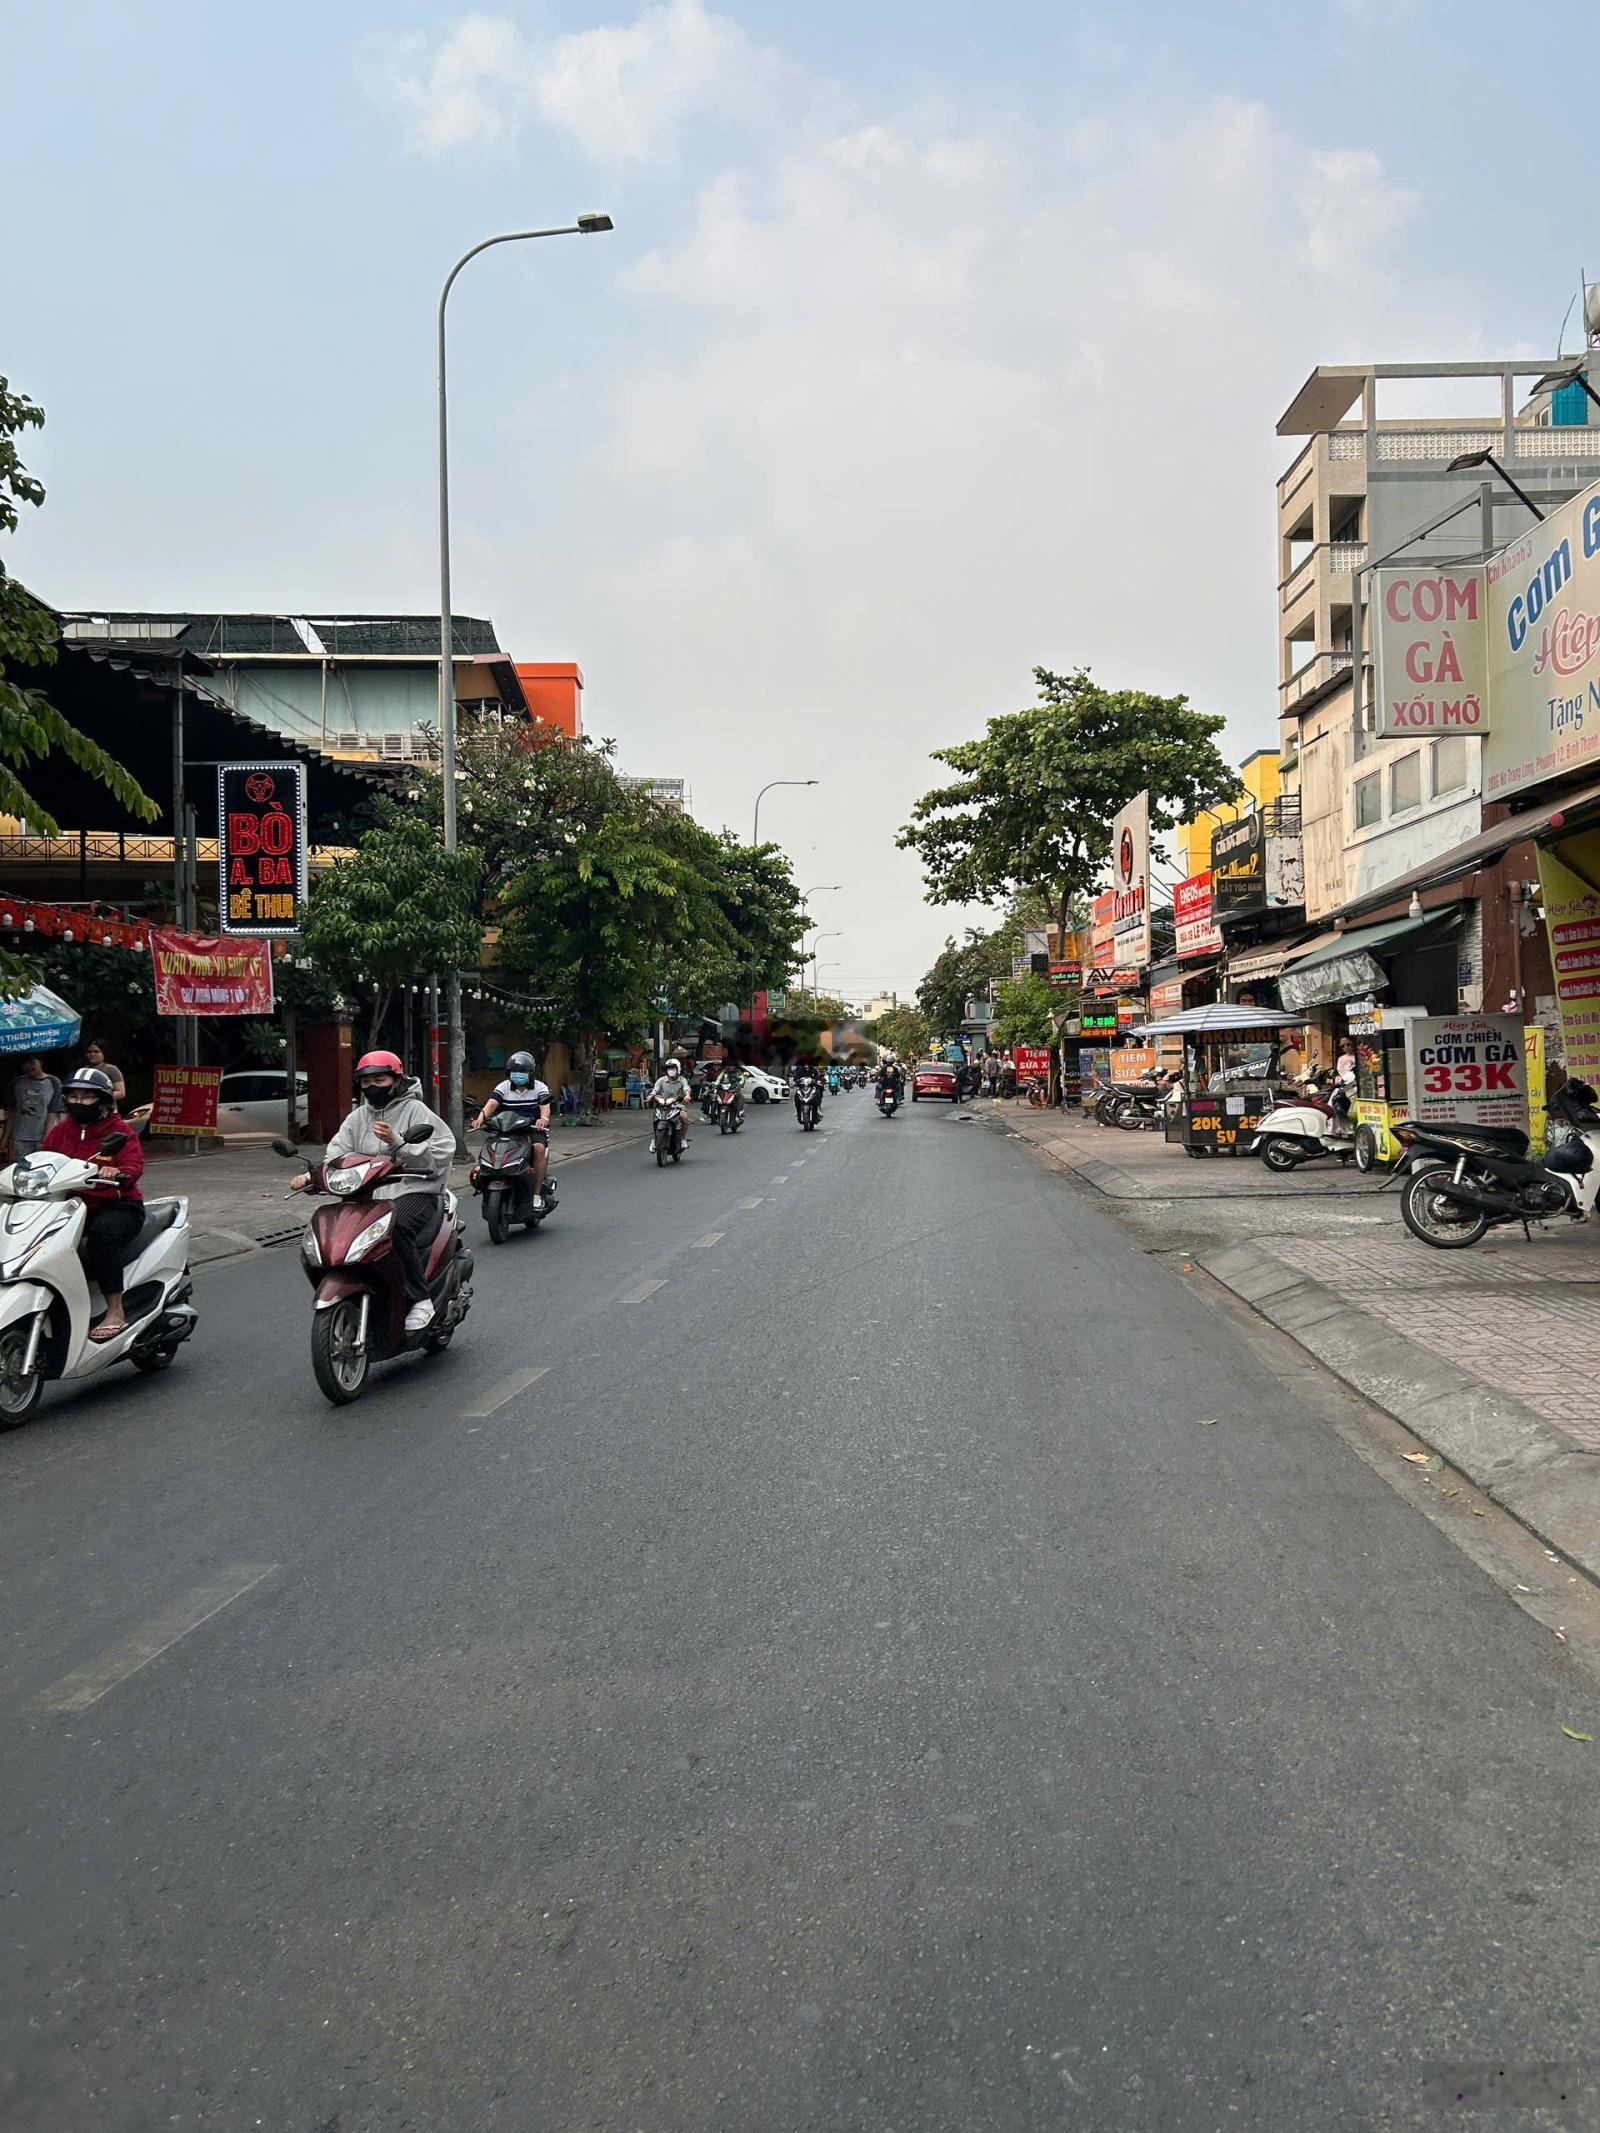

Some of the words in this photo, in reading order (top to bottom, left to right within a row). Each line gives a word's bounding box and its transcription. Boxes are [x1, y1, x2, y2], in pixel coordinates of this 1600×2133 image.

[1386, 576, 1479, 622] CƠM
[1508, 537, 1572, 651] Cơm
[1405, 630, 1464, 684] GÀ
[1532, 608, 1600, 675] Hiệp
[1392, 693, 1435, 727] XỐI
[1442, 694, 1480, 725] MỠ
[1547, 694, 1583, 735] Tặng
[229, 802, 293, 855] BÒ
[230, 858, 253, 885] A.
[258, 858, 293, 885] BA
[230, 888, 253, 919] BÊ
[255, 894, 294, 919] THUI
[1195, 1029, 1272, 1044] TAKOYAKI
[1434, 1033, 1464, 1045] CƠM
[1466, 1030, 1502, 1044] CHIÊN
[1248, 1061, 1268, 1072] NAM
[1420, 1045, 1476, 1065] CƠM
[1485, 1040, 1519, 1062] GÀ
[191, 1071, 219, 1088] DỤNG
[1424, 1062, 1517, 1093] 33K
[1192, 1116, 1222, 1131] 20K
